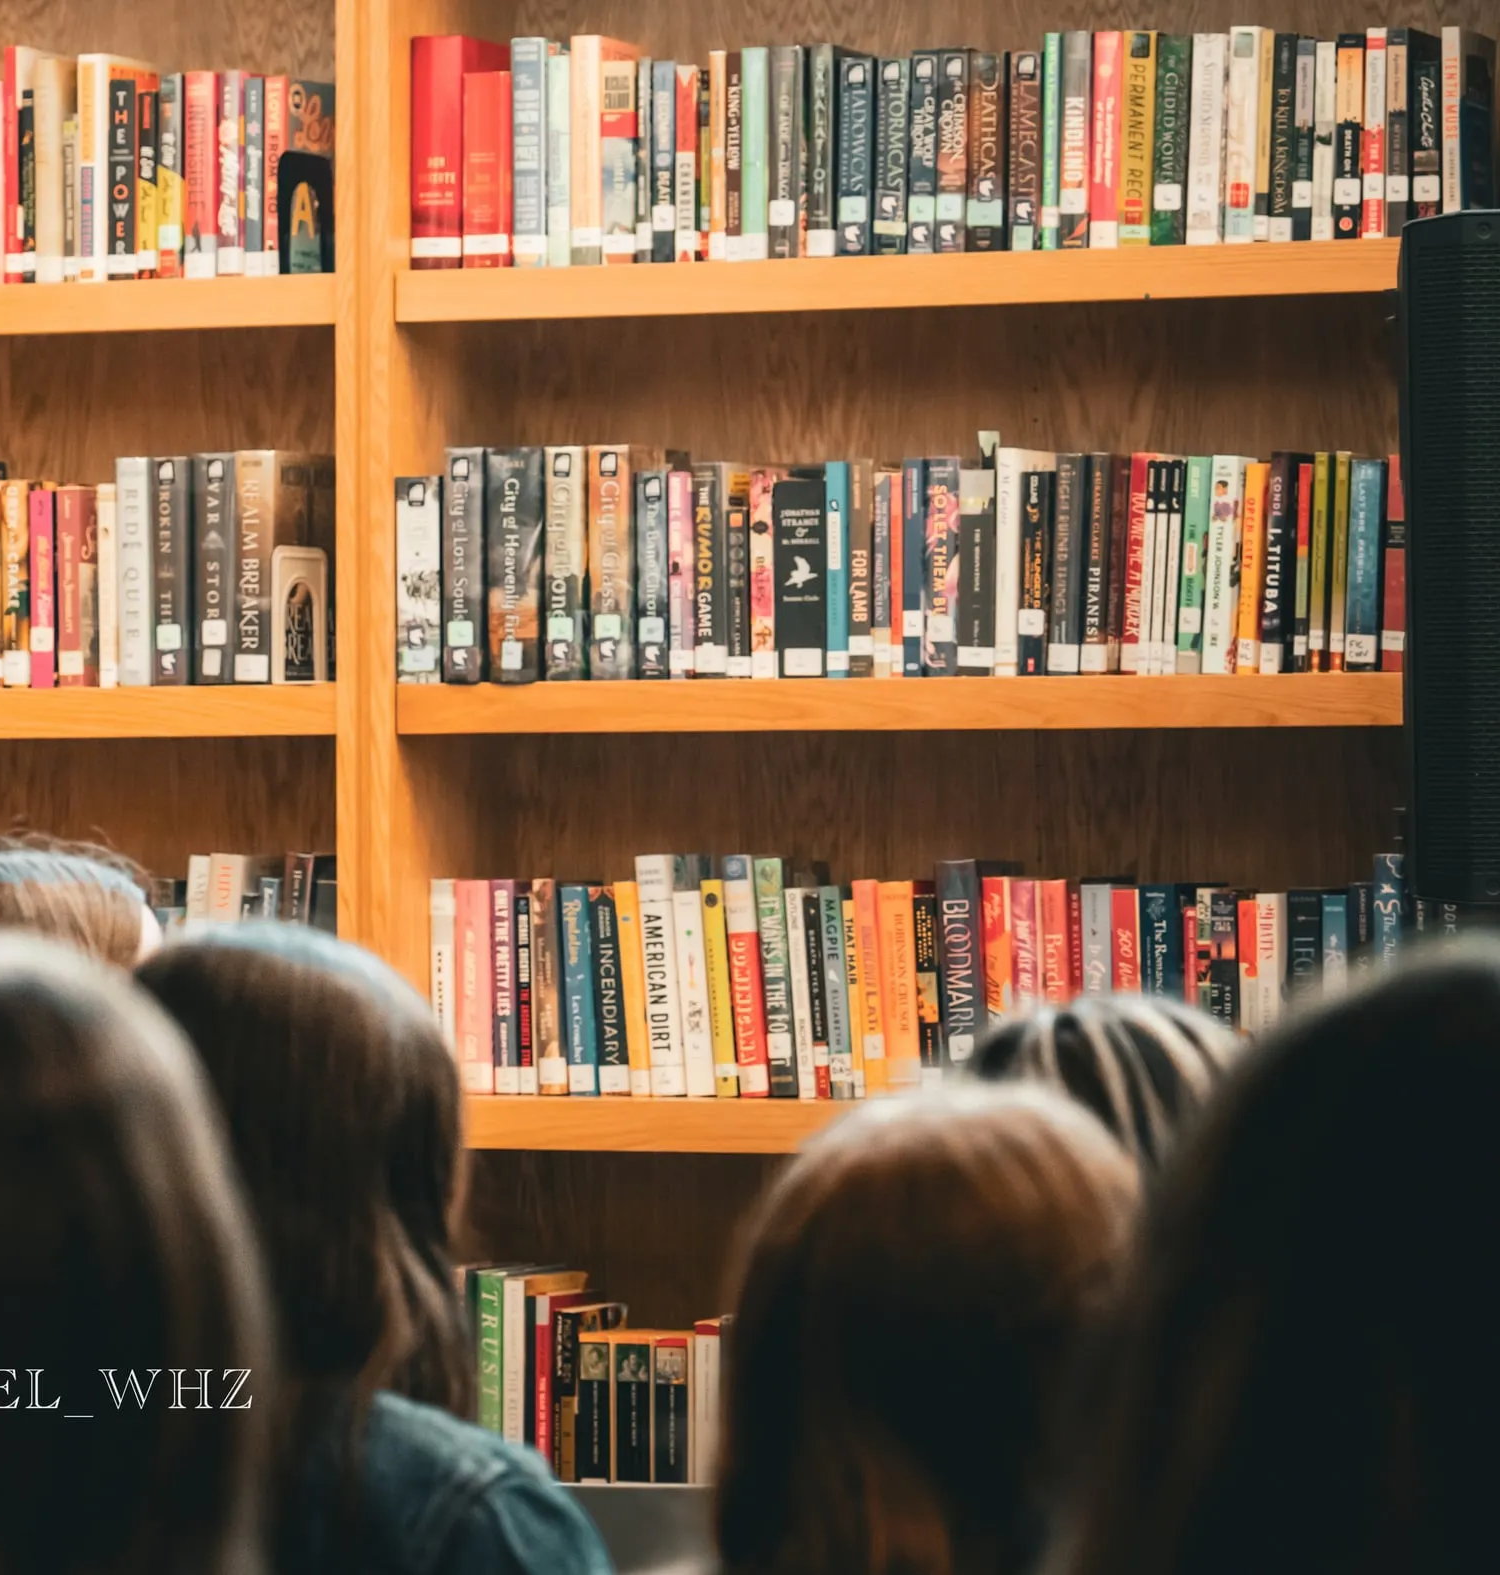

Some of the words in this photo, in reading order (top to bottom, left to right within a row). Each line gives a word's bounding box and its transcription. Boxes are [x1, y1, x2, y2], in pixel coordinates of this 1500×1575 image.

[1276, 87, 1291, 103] TO
[1445, 57, 1458, 98] TENTH
[114, 91, 127, 145] THE
[728, 85, 740, 118] KING
[923, 97, 934, 130] GRAY
[1129, 63, 1146, 160] PERMANENT
[1163, 72, 1179, 129] GILDED
[1275, 106, 1290, 131] KILL
[940, 100, 954, 154] CROWN
[952, 94, 966, 164] CRIMSON
[1343, 129, 1353, 157] DEATH
[1445, 104, 1459, 140] MUSE
[187, 104, 205, 211] INDIVISIBLE
[267, 135, 279, 177] FROM
[727, 125, 740, 171] YELLOW
[922, 135, 935, 168] WOLF
[1343, 158, 1352, 172] ON
[1272, 146, 1289, 214] KINGDOM
[113, 165, 129, 255] POWER
[124, 489, 139, 536] RED
[241, 479, 260, 550] REALM
[450, 481, 468, 516] City
[500, 477, 520, 513] City
[598, 480, 620, 525] City
[699, 487, 710, 505] THE
[933, 484, 947, 509] SO
[1245, 497, 1256, 533] OPEN
[1271, 475, 1283, 517] CONDÉ
[1358, 482, 1366, 508] LAST
[502, 516, 518, 530] of
[933, 513, 947, 540] LET
[1214, 526, 1225, 554] TYLER
[453, 537, 468, 572] Lost
[696, 506, 712, 592] RUMOR
[851, 549, 868, 578] FOR
[933, 545, 948, 593] THEM
[1243, 539, 1254, 570] CITY
[8, 552, 21, 608] CRAKE
[206, 561, 220, 619] STOR
[502, 534, 519, 609] Heavenly
[600, 551, 622, 607] Glass
[1033, 553, 1042, 597] HUNGER
[1212, 555, 1223, 601] JOHNSON
[1263, 544, 1282, 614] TITUBA
[123, 567, 139, 640] QUEE
[239, 558, 260, 649] BREAKER
[453, 577, 468, 620] Souls
[698, 592, 712, 637] GAME
[849, 582, 868, 622] LAMB
[1085, 567, 1101, 643] PIRANESI
[1124, 583, 1142, 637] MURDER
[504, 614, 520, 644] Fire
[494, 889, 509, 918] ONLY
[495, 921, 510, 943] THE
[563, 898, 582, 968] Reputation
[824, 898, 839, 961] MAGPIE
[844, 918, 855, 949] THAT
[894, 913, 907, 979] ROBINSON
[1116, 928, 1133, 957] 500
[1154, 919, 1166, 943] The
[495, 945, 511, 988] PRETTY
[643, 913, 667, 1005] AMERICAN
[764, 963, 784, 978] IN
[846, 954, 857, 986] HAIR
[1019, 972, 1033, 987] ME
[496, 991, 511, 1017] LIES
[599, 942, 621, 1065] INCENDIARY
[765, 983, 788, 1011] THE
[831, 989, 842, 1046] ELIZABETH
[897, 983, 911, 1036] CRUSOE
[649, 1013, 671, 1052] DIRT
[480, 1289, 500, 1400] TRUST
